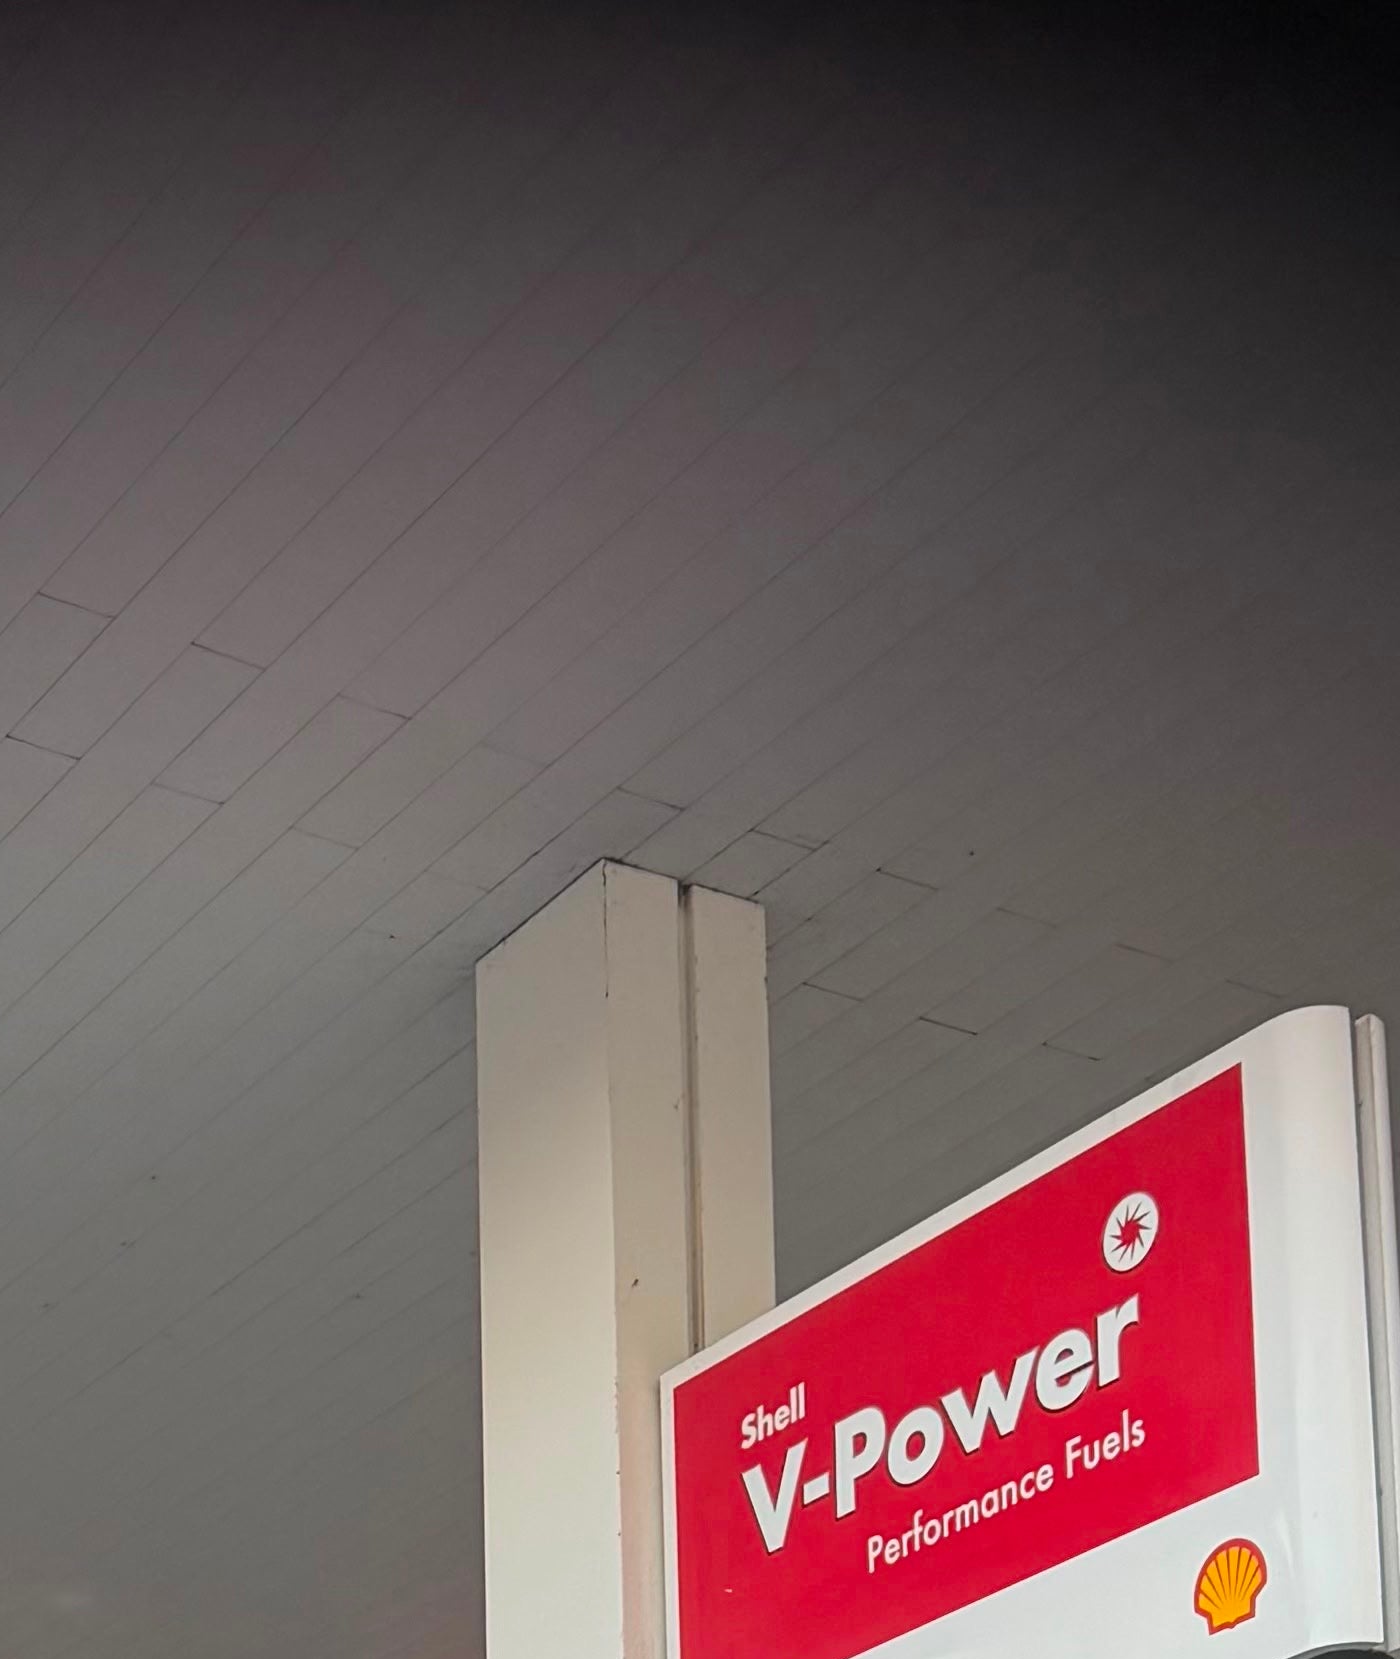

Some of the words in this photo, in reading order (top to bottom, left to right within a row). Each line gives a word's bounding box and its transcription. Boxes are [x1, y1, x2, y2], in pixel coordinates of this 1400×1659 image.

[741, 1382, 805, 1449] Shell
[741, 1293, 1140, 1555] V-Power
[867, 1462, 1054, 1573] Performance
[1065, 1409, 1146, 1480] Fuels
